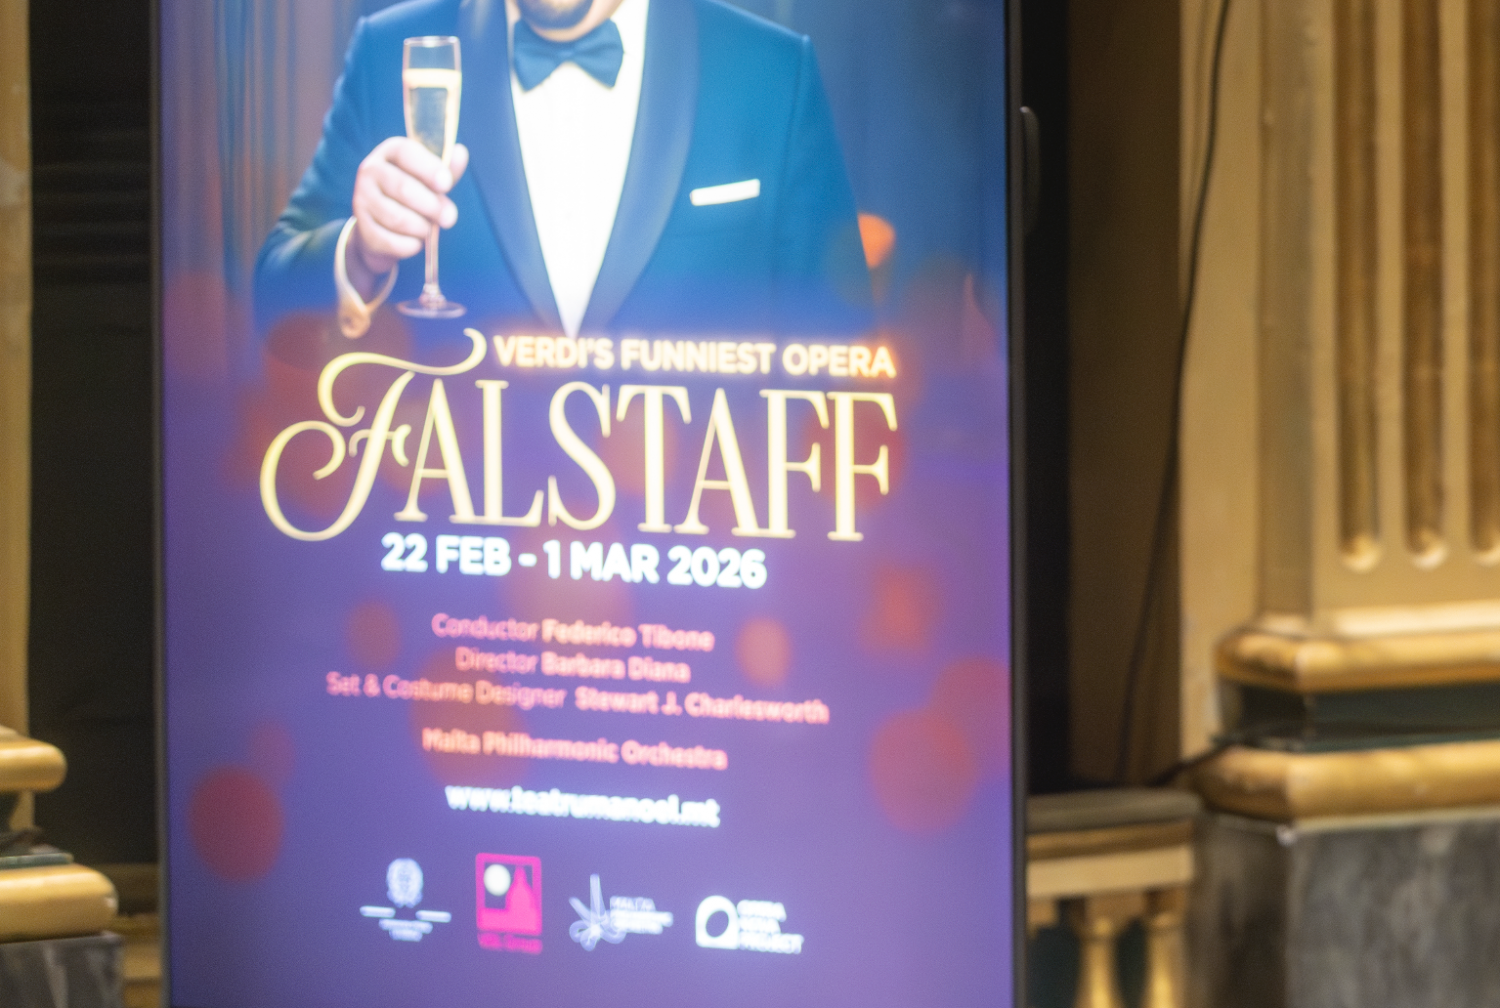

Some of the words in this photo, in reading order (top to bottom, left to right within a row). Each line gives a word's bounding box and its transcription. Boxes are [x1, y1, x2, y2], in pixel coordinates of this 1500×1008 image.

[494, 335, 614, 369] VERDI'S
[621, 338, 776, 373] FUNNIEST
[782, 344, 897, 379] OPERA
[259, 328, 898, 542] FALSTAFF
[381, 532, 429, 573] 22
[435, 535, 511, 576] FEB
[543, 540, 561, 579] 1
[570, 542, 660, 584] MAR
[668, 546, 767, 590] 2026
[431, 613, 540, 641] Conductor
[542, 619, 637, 648] Federico
[455, 646, 538, 674] Director
[541, 652, 625, 680] Barbara
[628, 656, 691, 684] Diana
[326, 671, 361, 696] Set
[363, 674, 380, 697] &
[383, 674, 474, 704] Costume
[475, 680, 566, 710] Designer
[575, 685, 659, 714] Stewart
[684, 691, 830, 724] Charlesworth
[422, 727, 481, 754] Malta
[482, 730, 619, 764] Philharmonic
[621, 739, 728, 771] Orchestra
